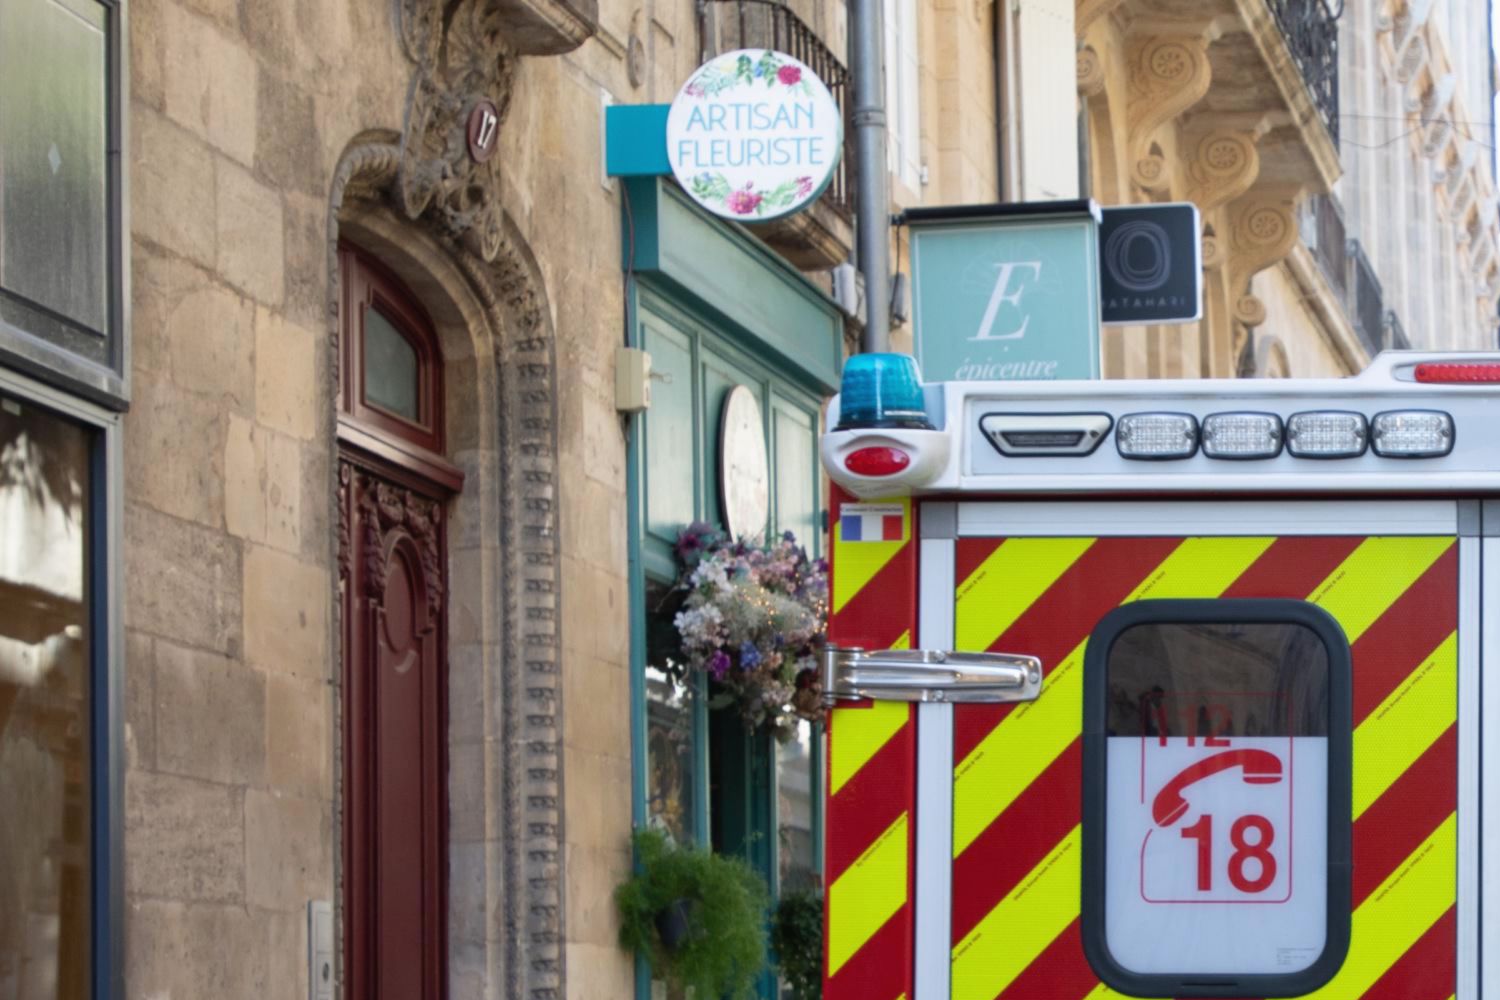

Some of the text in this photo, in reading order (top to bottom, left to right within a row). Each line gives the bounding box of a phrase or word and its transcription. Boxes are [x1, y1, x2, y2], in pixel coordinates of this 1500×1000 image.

[477, 110, 497, 149] 17
[686, 102, 814, 132] ARTISAN
[678, 136, 824, 167] FLEURISTE
[1102, 295, 1185, 308] ATAHARI
[954, 357, 1058, 381] épicentre
[1152, 703, 1232, 747] 112
[1181, 814, 1277, 893] 18
